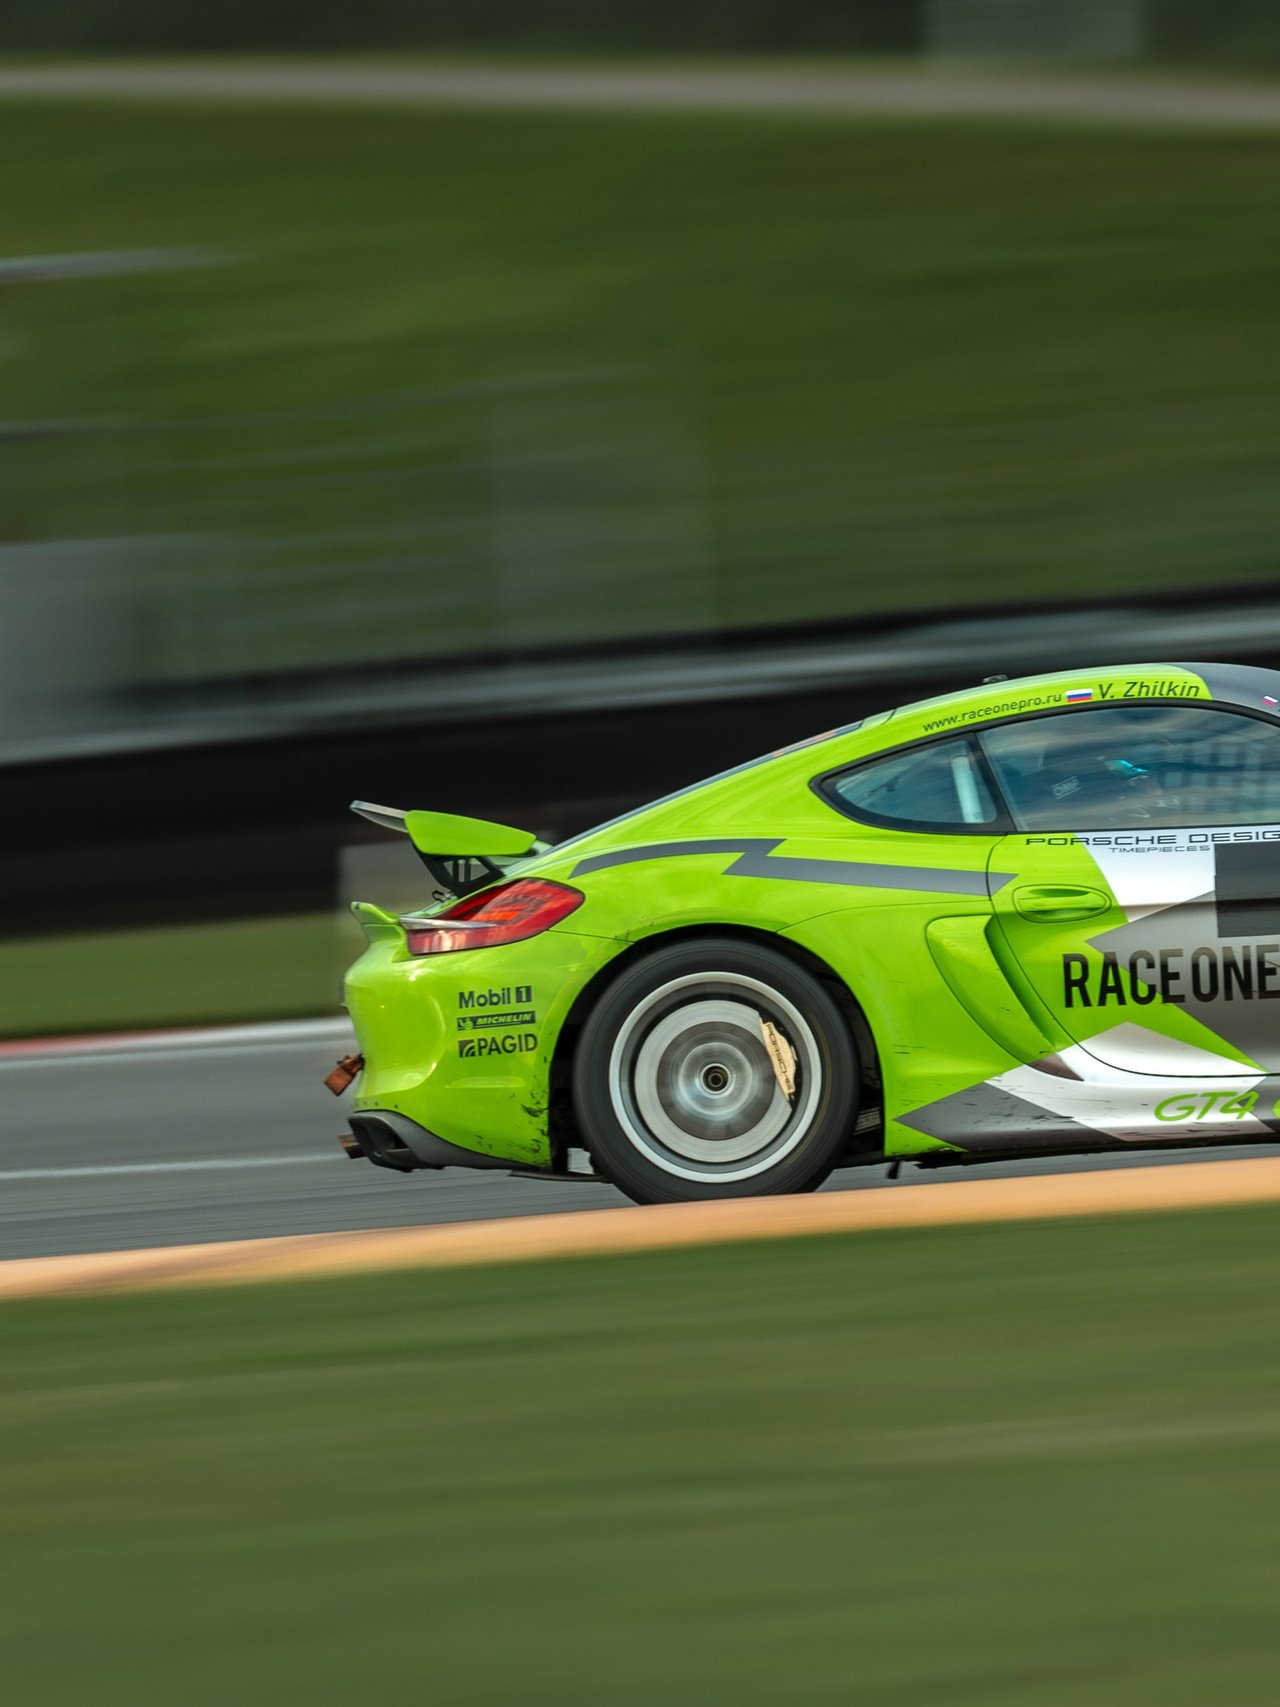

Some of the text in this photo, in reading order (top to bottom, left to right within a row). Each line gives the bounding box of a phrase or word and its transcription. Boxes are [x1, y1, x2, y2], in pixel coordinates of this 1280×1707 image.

[1098, 681, 1200, 699] V. Zhilkin
[922, 693, 1062, 732] www.raceonepro.ru
[1025, 834, 1177, 846] PORSCHE
[1108, 844, 1211, 854] TIMEPIECES
[458, 987, 511, 1009] Mobil
[476, 1012, 532, 1025] MICHELIN
[477, 1033, 538, 1056] PAGID
[766, 1023, 794, 1090] PORSCHE
[1154, 1091, 1259, 1121] GT4
